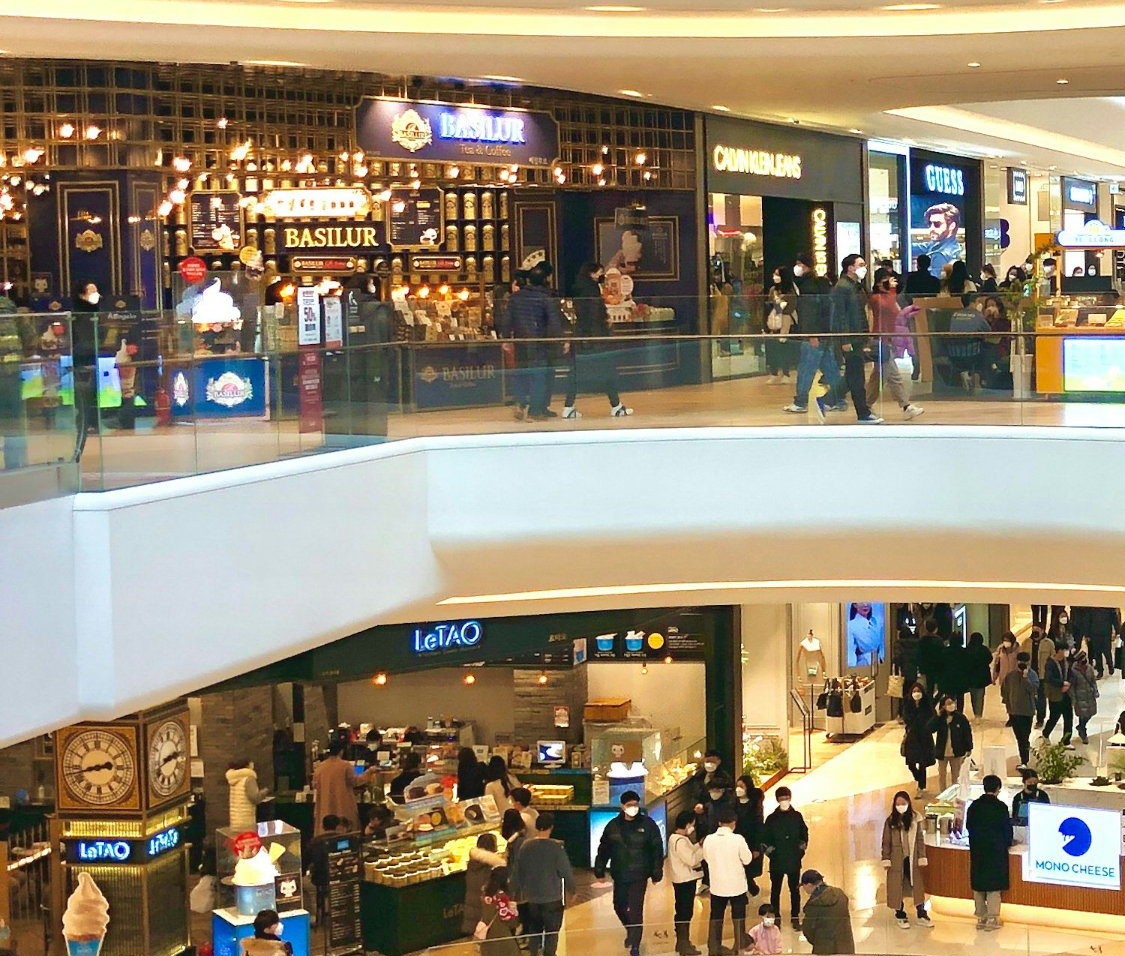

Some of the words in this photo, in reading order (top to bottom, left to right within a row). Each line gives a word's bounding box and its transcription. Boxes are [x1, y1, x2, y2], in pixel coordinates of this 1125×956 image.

[439, 112, 526, 144] BASILUR
[460, 144, 475, 155] Tea
[476, 146, 485, 155] &
[485, 146, 512, 157] Coffee
[714, 145, 750, 174] CALVIN
[750, 150, 774, 177] KLEIN
[773, 154, 802, 180] JEANS
[926, 164, 965, 196] GUESS
[284, 227, 379, 248] BASILUR
[442, 365, 496, 381] BASILUR
[414, 620, 481, 652] LeTAO
[79, 841, 131, 860] LeTAO
[1035, 860, 1070, 873] MONO
[1071, 864, 1115, 878] CHEESE
